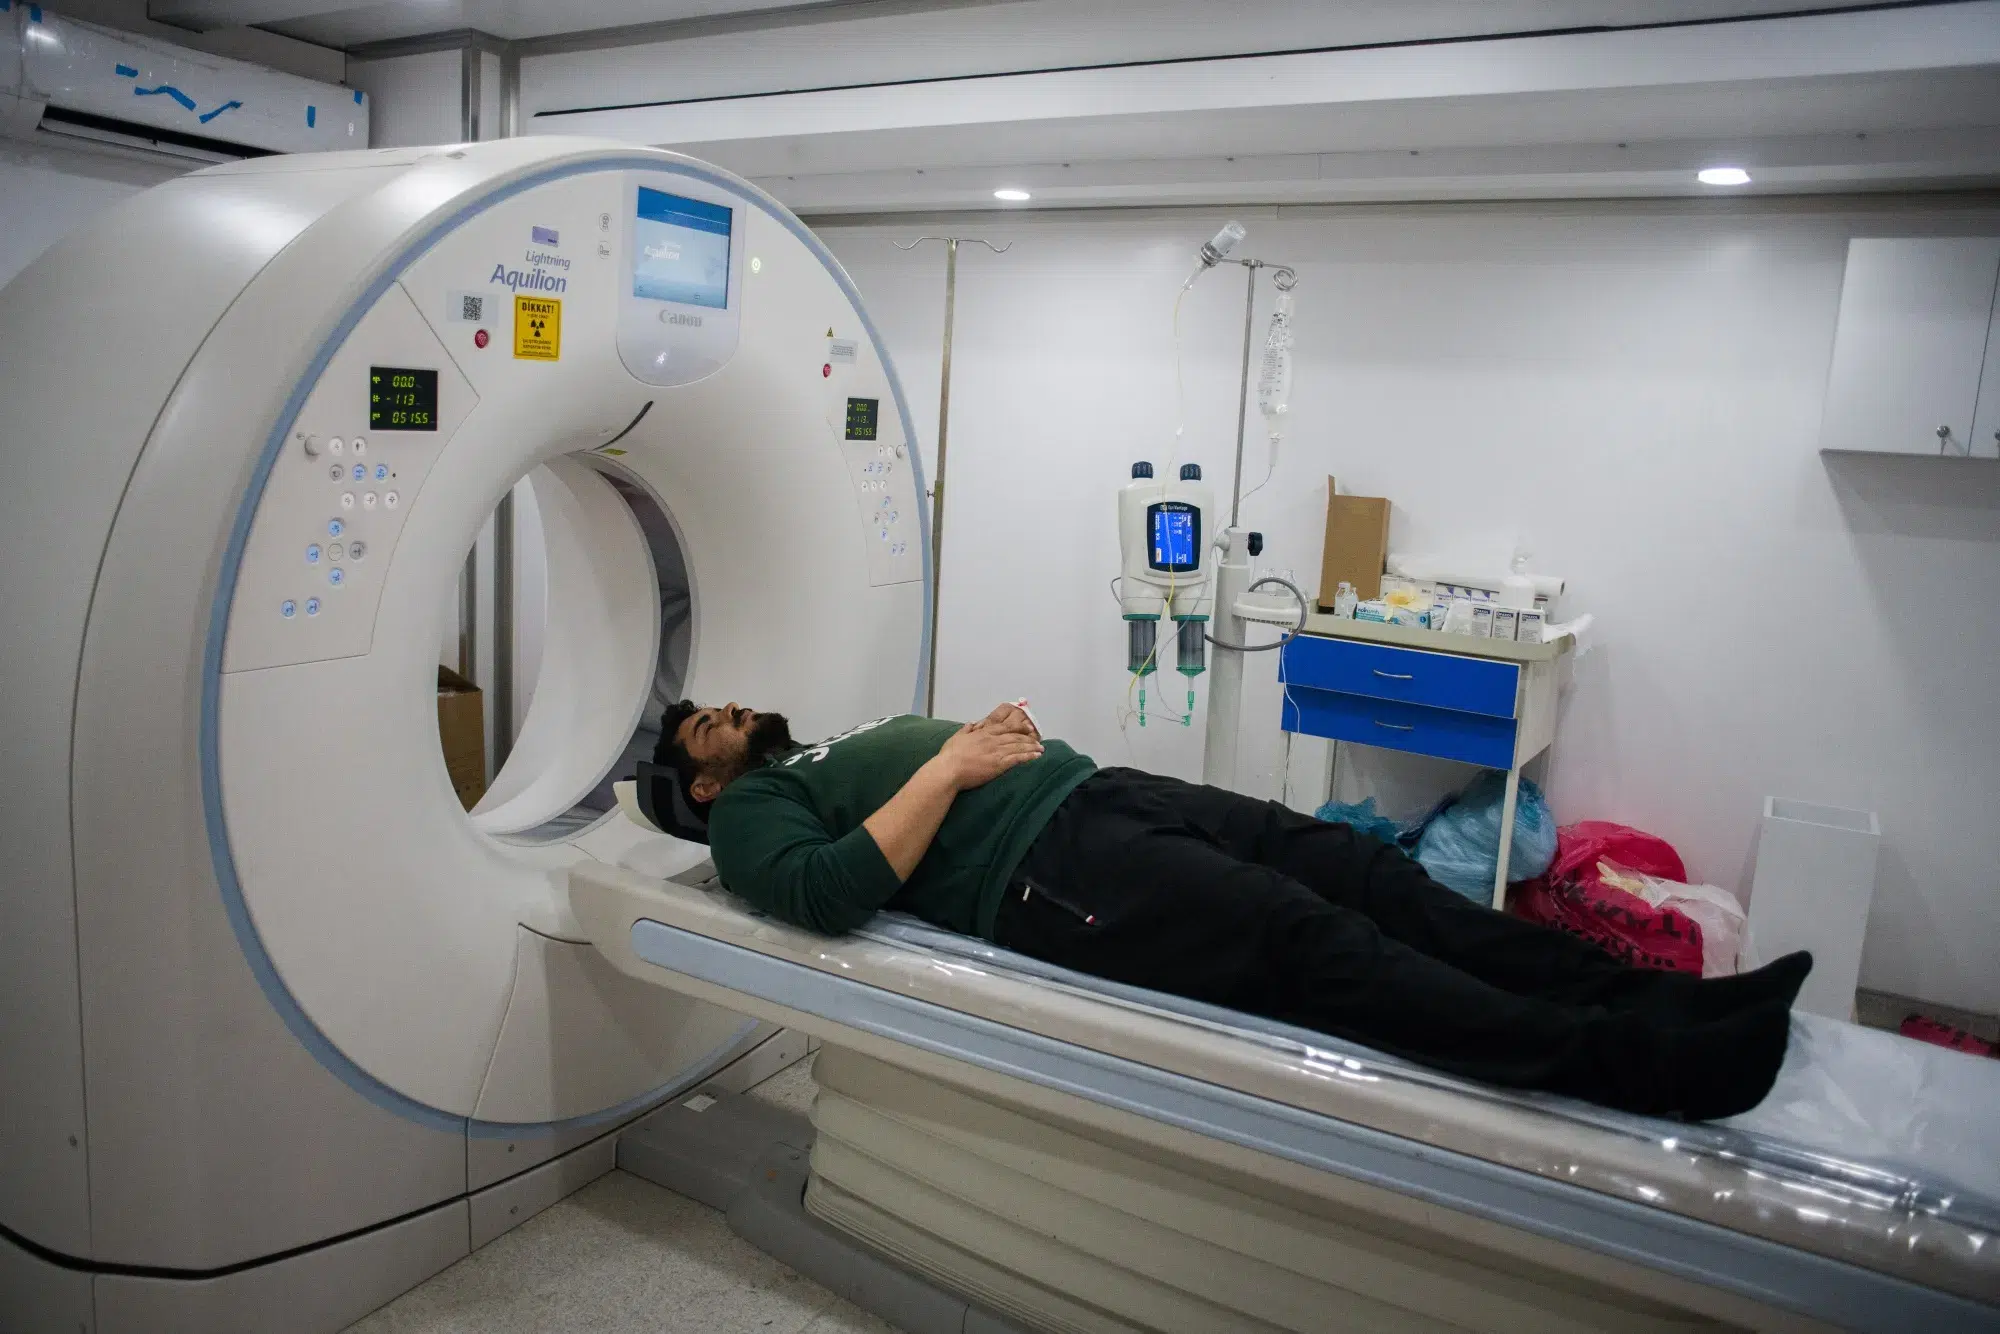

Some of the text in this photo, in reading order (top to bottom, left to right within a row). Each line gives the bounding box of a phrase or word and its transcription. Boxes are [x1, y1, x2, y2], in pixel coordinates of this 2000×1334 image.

[525, 250, 570, 270] Lightning
[489, 263, 567, 292] Aquilion
[659, 308, 703, 328] Canon
